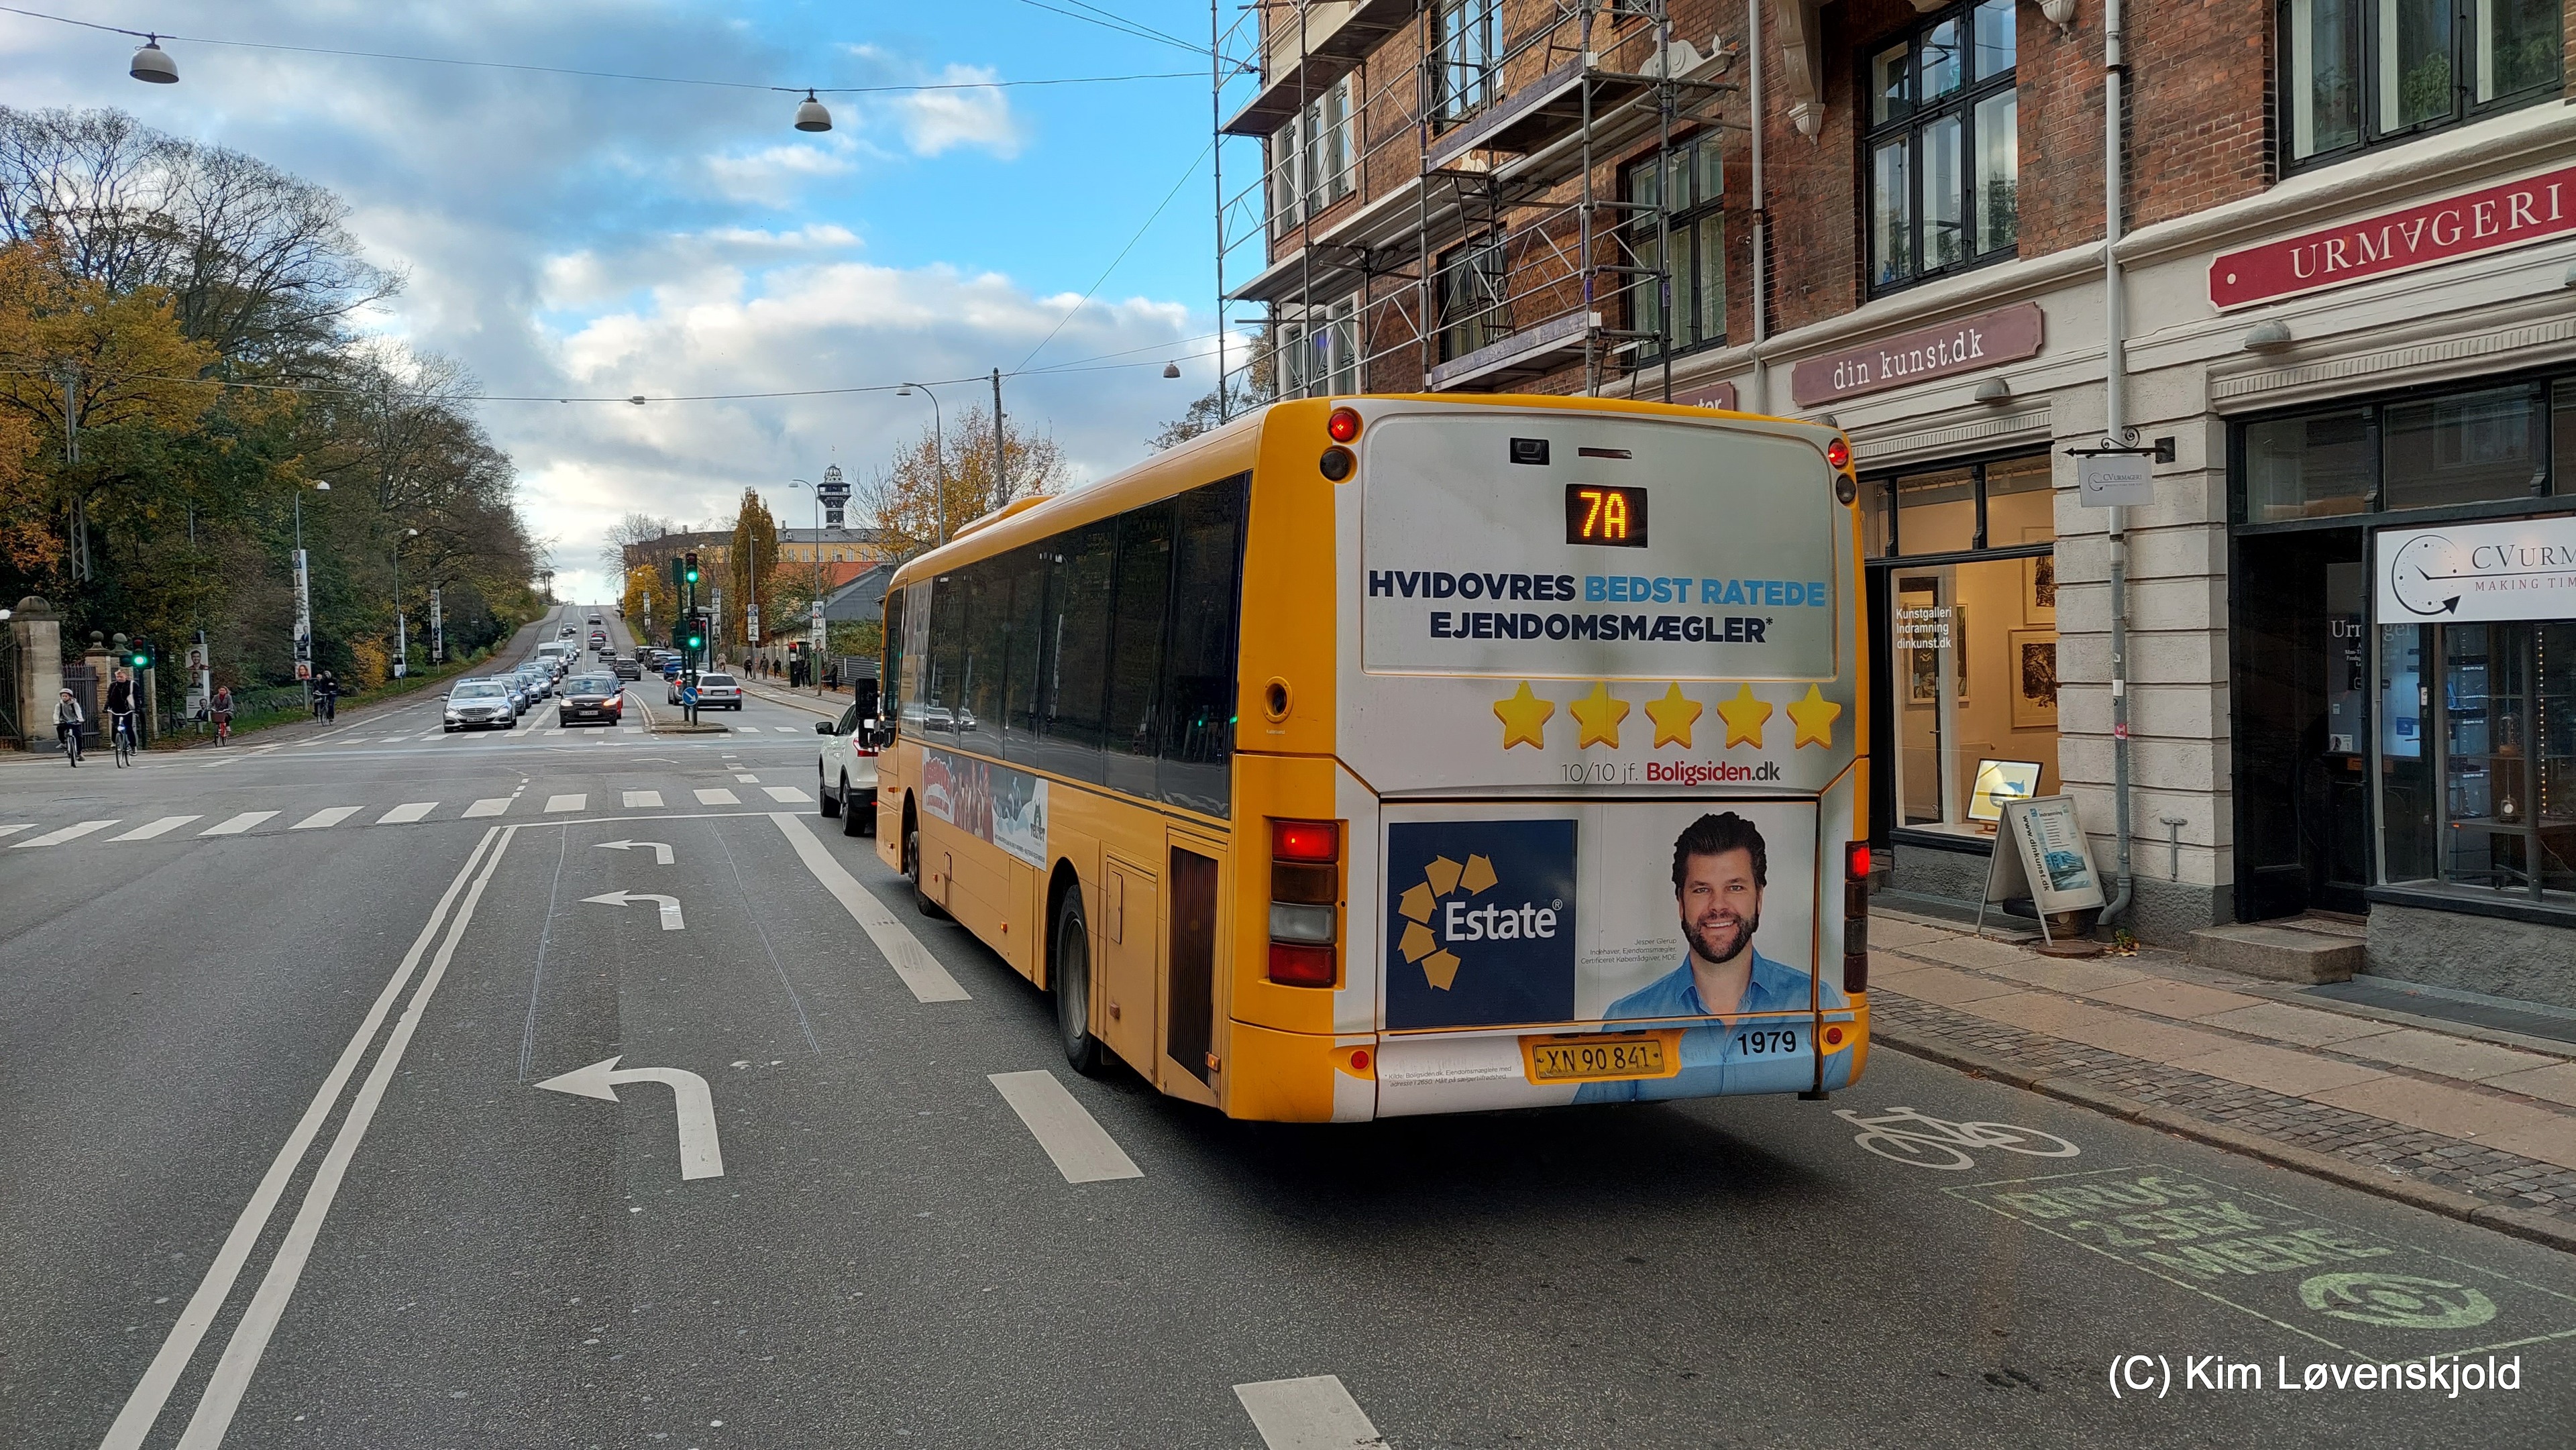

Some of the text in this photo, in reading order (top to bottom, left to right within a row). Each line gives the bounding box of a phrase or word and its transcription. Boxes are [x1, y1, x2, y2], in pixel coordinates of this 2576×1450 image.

[1833, 328, 1984, 390] din kunst.dk
[1580, 492, 1626, 539] 7A
[1368, 570, 1826, 607] HVIDOVRES BEDST RATEDE
[2475, 578, 2539, 592] MAKING
[1896, 606, 1952, 621] Kunstgalleri
[1896, 622, 1949, 636] Indramning
[1897, 638, 1952, 650] dinkunst.dk
[1562, 761, 1781, 787] 10/10 jf. Boligsiden.dk
[2023, 815, 2050, 892] www.dinkunst.dk
[1738, 1031, 1796, 1055] 1979
[1545, 1044, 1650, 1073] XN 90 841
